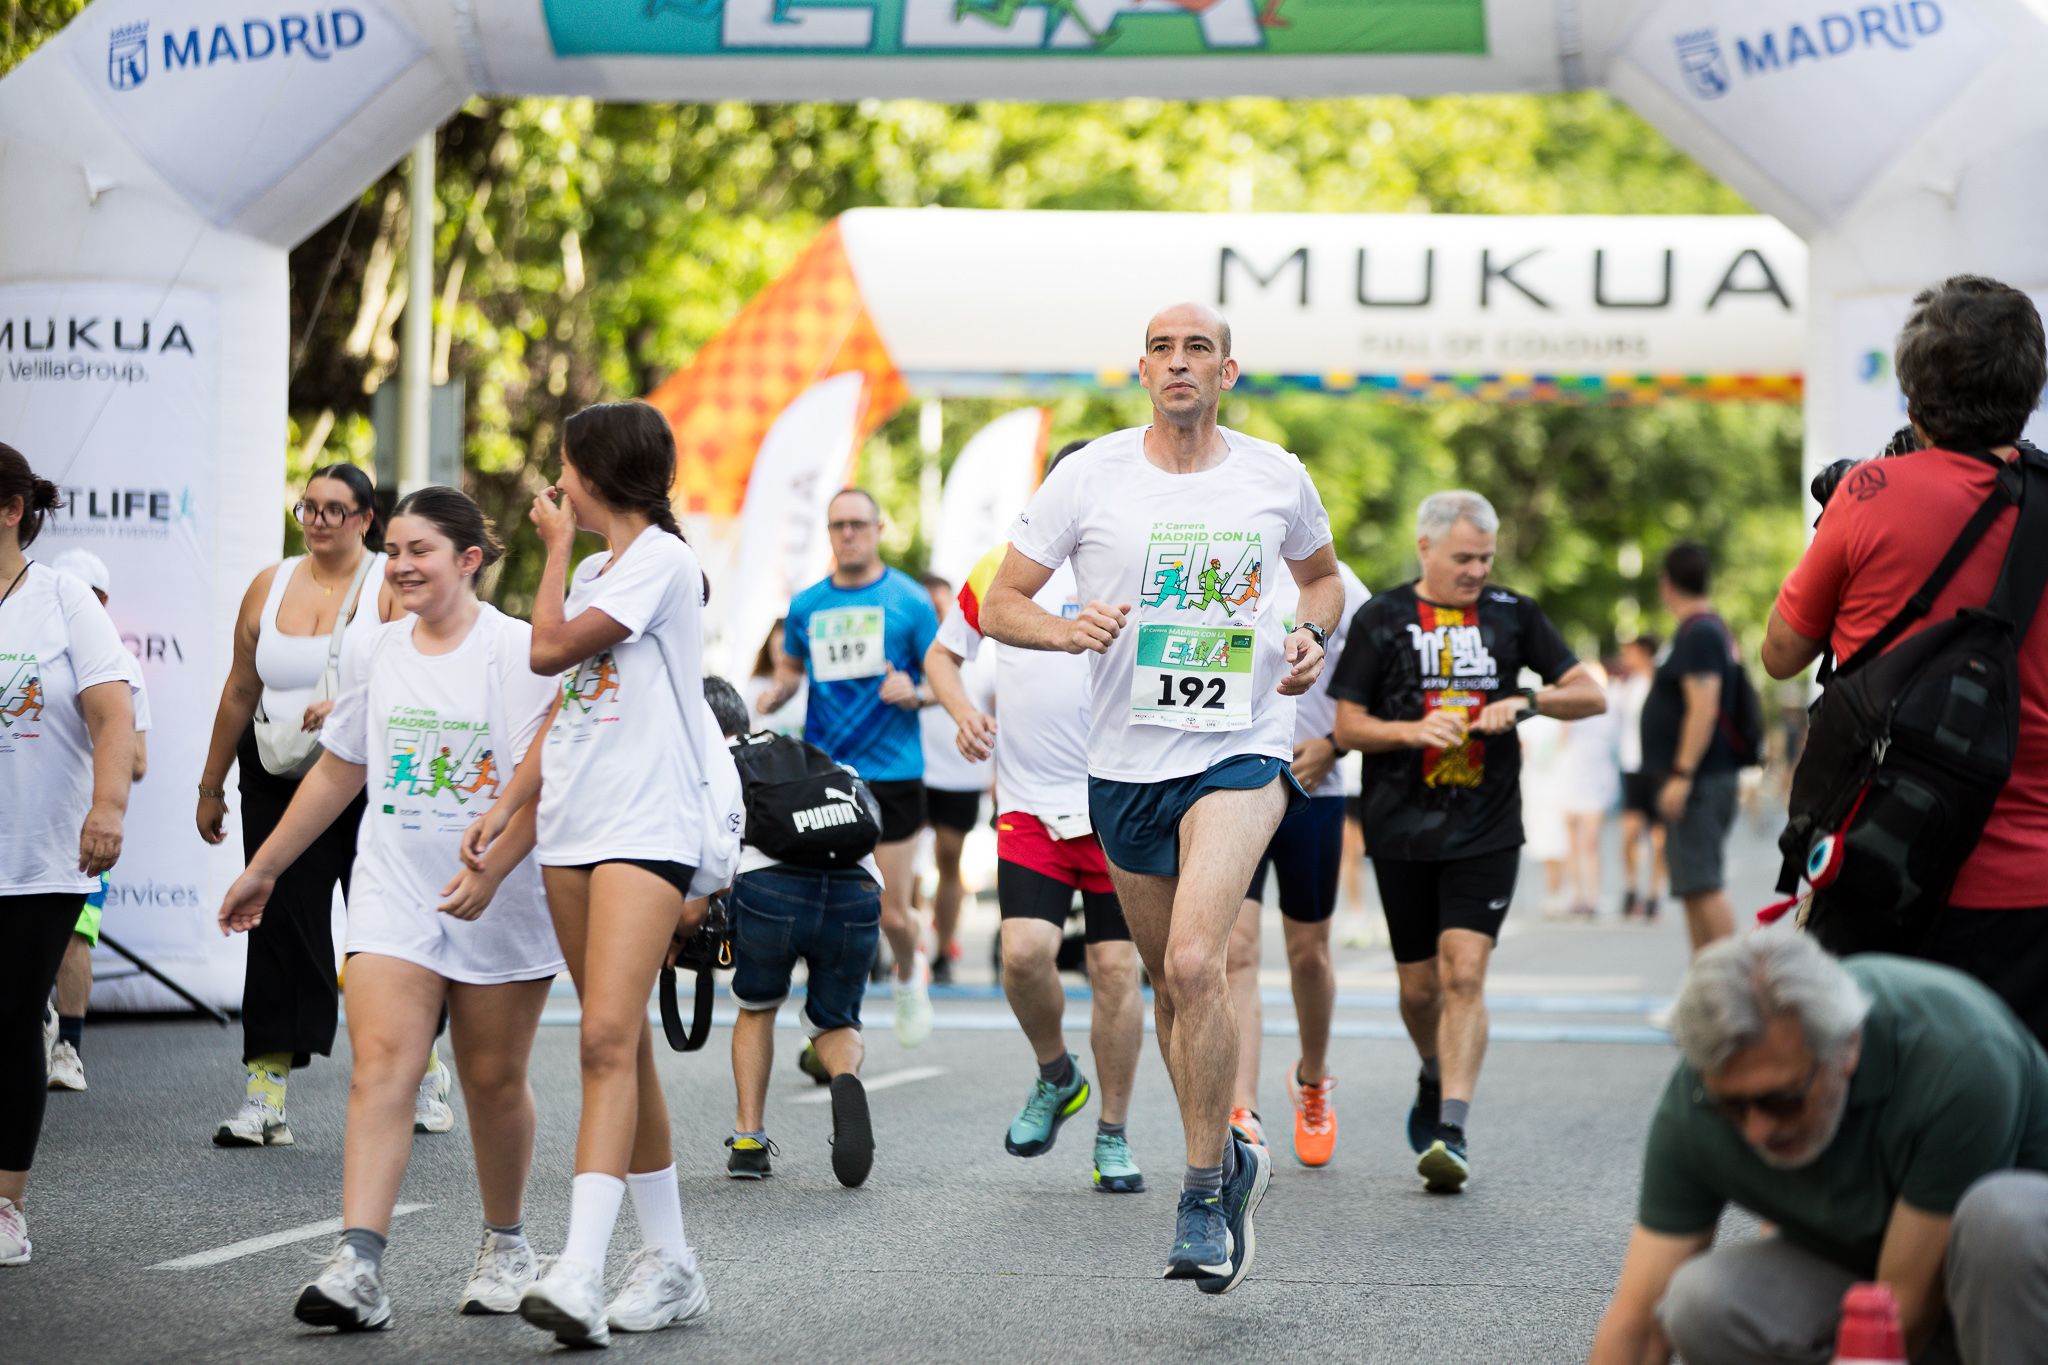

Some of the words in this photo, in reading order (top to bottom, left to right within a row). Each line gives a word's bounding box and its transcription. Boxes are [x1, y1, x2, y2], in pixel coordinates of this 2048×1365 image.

[163, 8, 366, 72] MADRID
[1736, 0, 1945, 76] MADRID
[1216, 246, 1793, 311] MUKUA
[1150, 532, 1209, 542] MADRID
[1213, 532, 1243, 542] CON
[1246, 532, 1261, 543] LA
[1166, 522, 1205, 530] Carrera
[1141, 543, 1263, 596] ELA
[1168, 628, 1200, 637] MADRID
[1200, 630, 1216, 638] CON
[0, 653, 18, 661] ON
[1160, 635, 1228, 668] ELA
[1157, 674, 1227, 710] 192
[388, 716, 439, 729] MADRID
[442, 720, 471, 731] CON
[473, 722, 490, 731] LA
[792, 802, 857, 833] PUMA
[105, 878, 199, 907] ervices
